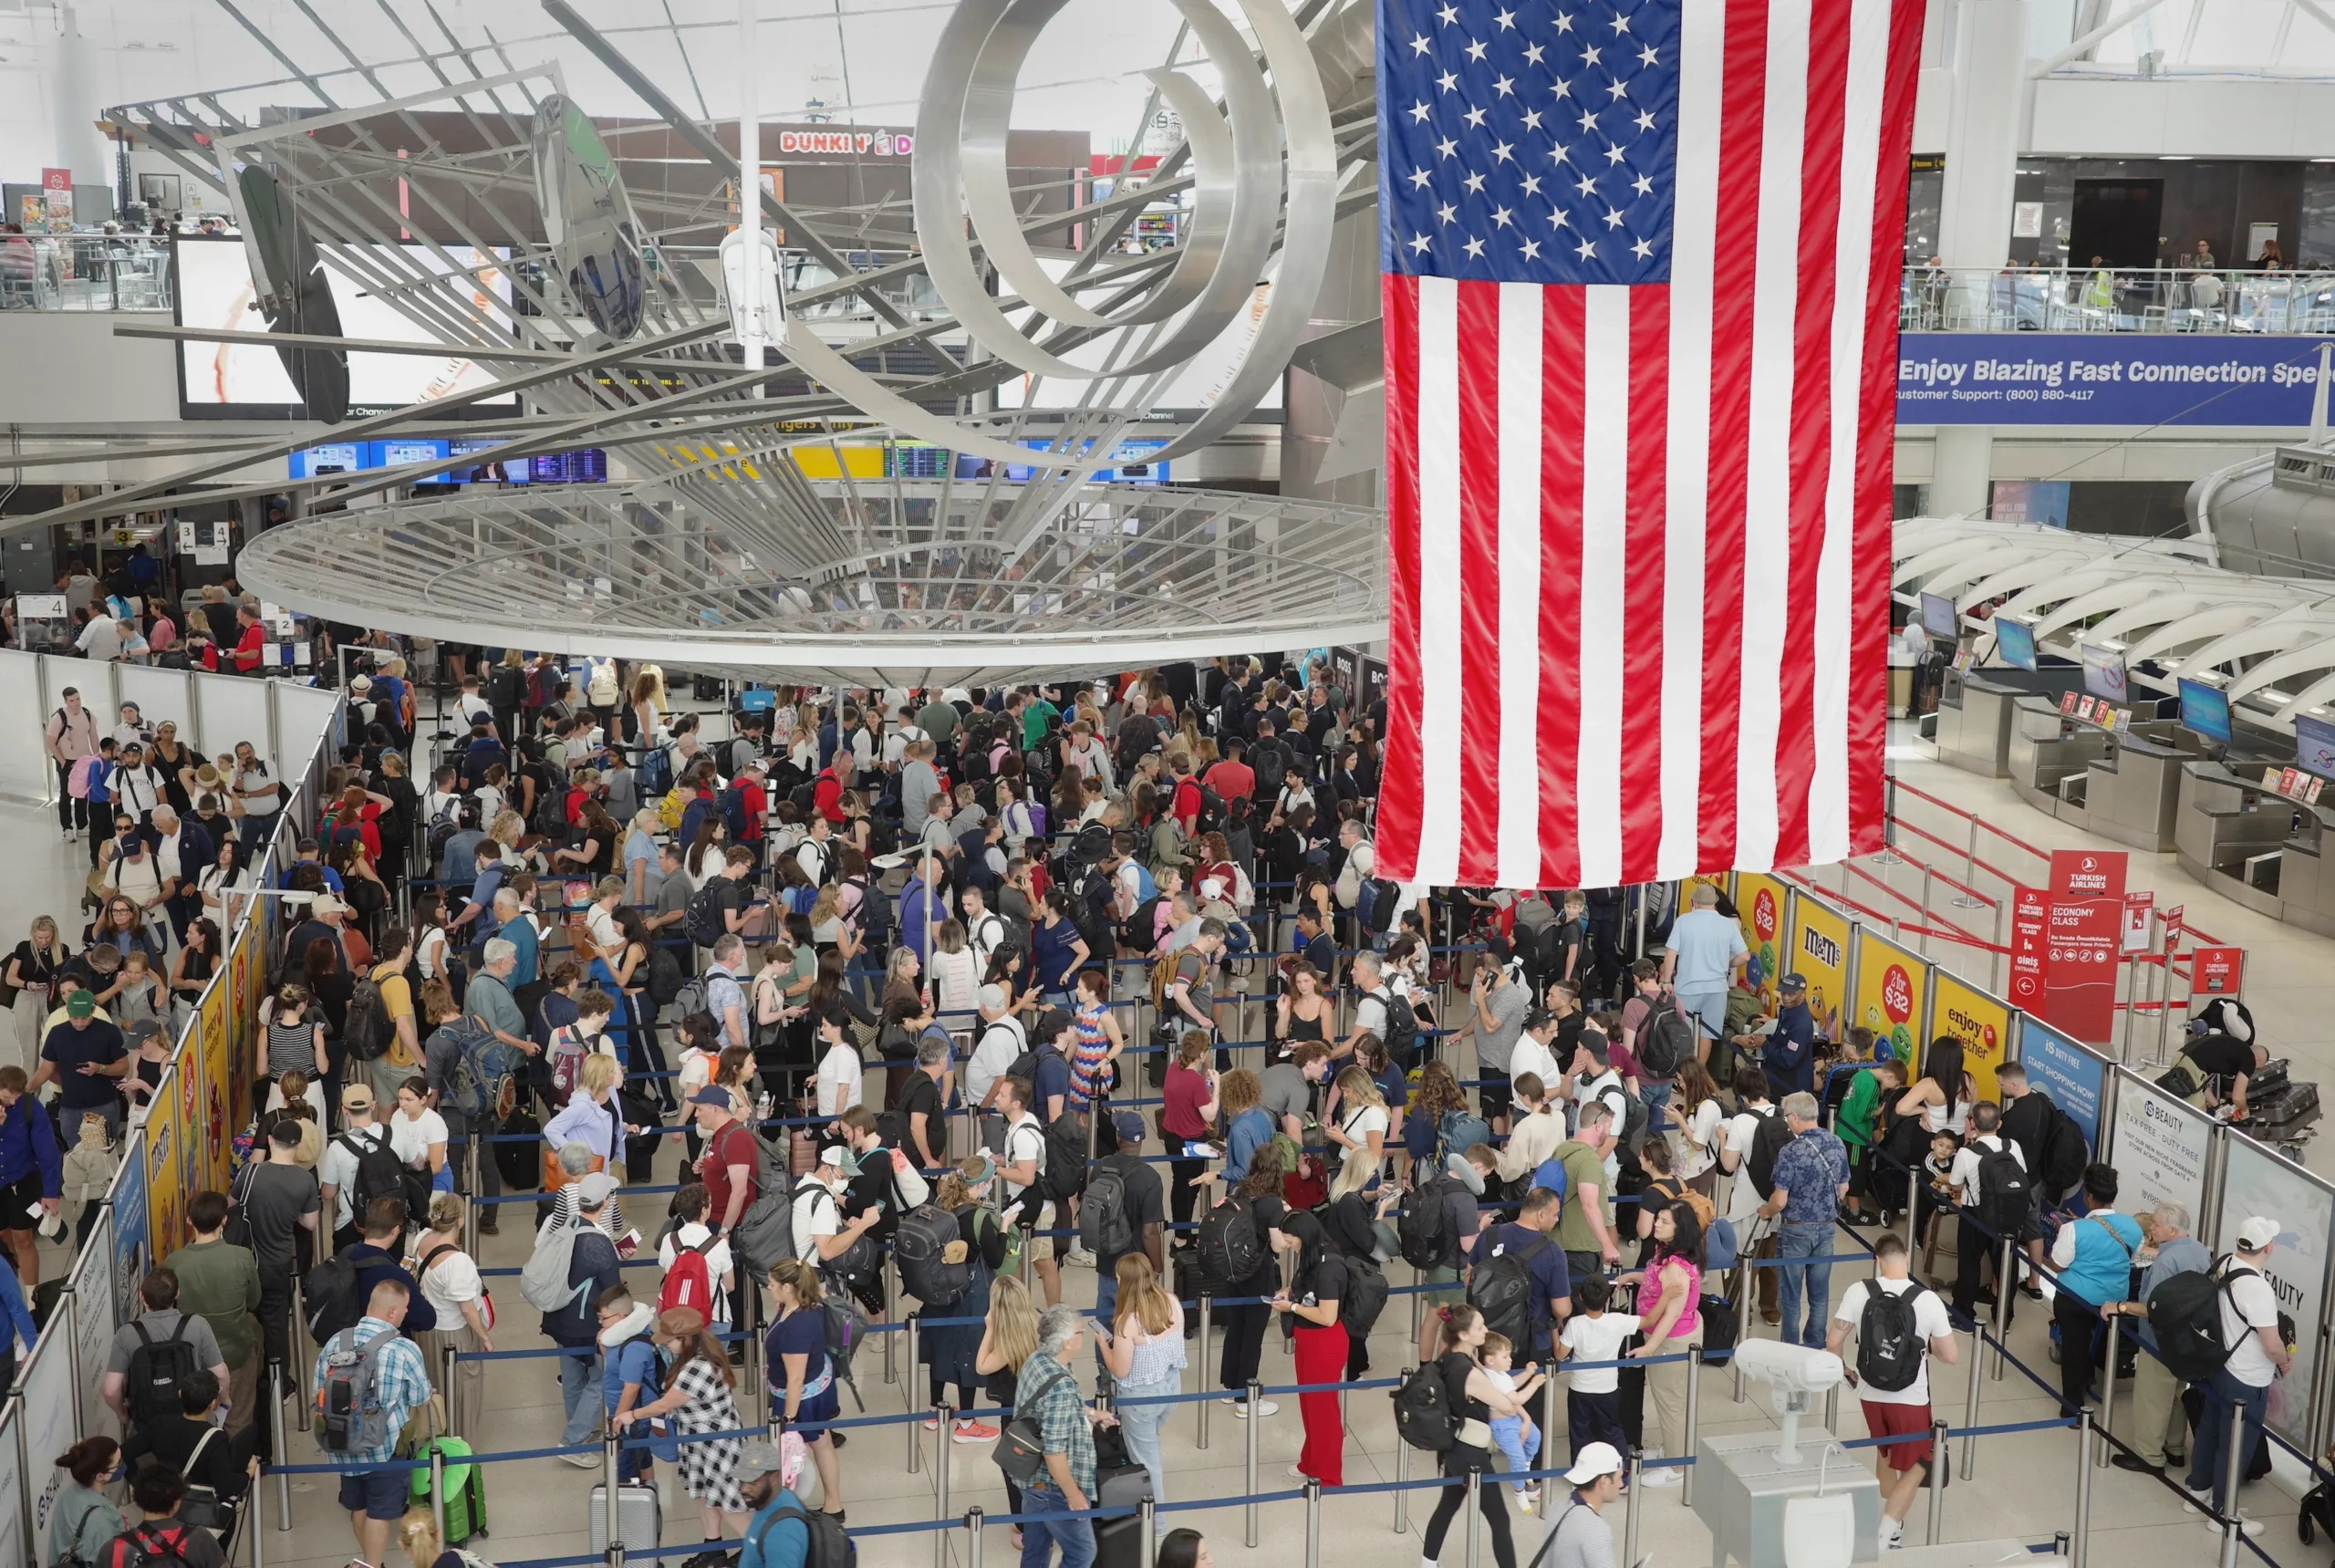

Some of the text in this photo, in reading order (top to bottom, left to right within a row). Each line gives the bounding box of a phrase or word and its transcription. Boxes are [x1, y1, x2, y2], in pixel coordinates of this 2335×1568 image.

[781, 132, 873, 153] DUNKIN'
[1899, 358, 2335, 388] Enjoy Blazing Fast Connection Spe
[1952, 389, 2003, 401] Support:
[2006, 389, 2039, 401] (800)
[2042, 389, 2094, 400] 880-4117
[119, 531, 129, 542] 3
[183, 527, 191, 536] 3
[217, 527, 225, 536] 4
[52, 601, 62, 615] 4
[282, 621, 290, 629] 2
[1336, 656, 1352, 674] BOSS
[1371, 670, 1387, 684] BO
[2070, 874, 2106, 882] TURKISH
[1759, 893, 1766, 909] 2
[1756, 909, 1773, 932] $32
[2052, 907, 2094, 917] ECONOMY
[2018, 922, 2041, 930] ECONOMY
[2051, 917, 2079, 926] CLASS
[2014, 965, 2040, 974] ENTRANCE
[1891, 971, 1906, 993] 2 for
[1884, 985, 1908, 1014] $32
[1948, 1008, 1982, 1038] enjoy
[2055, 1048, 2067, 1063] DUTY
[2068, 1054, 2080, 1070] FREE
[2027, 1055, 2095, 1101] START SHOPPING NOW!
[2154, 1106, 2184, 1134] BEAUTY
[2125, 1112, 2199, 1163] TAX FREE DUTY FREE
[2124, 1130, 2197, 1179] VISIT OUR NEW NICHE FRAGRANCE
[2128, 1141, 2143, 1154] STORE
[2143, 1150, 2160, 1165] ACROSS
[2161, 1160, 2174, 1172] FROM
[2174, 1168, 2186, 1181] GATE
[2264, 1269, 2304, 1311] EAUTY
